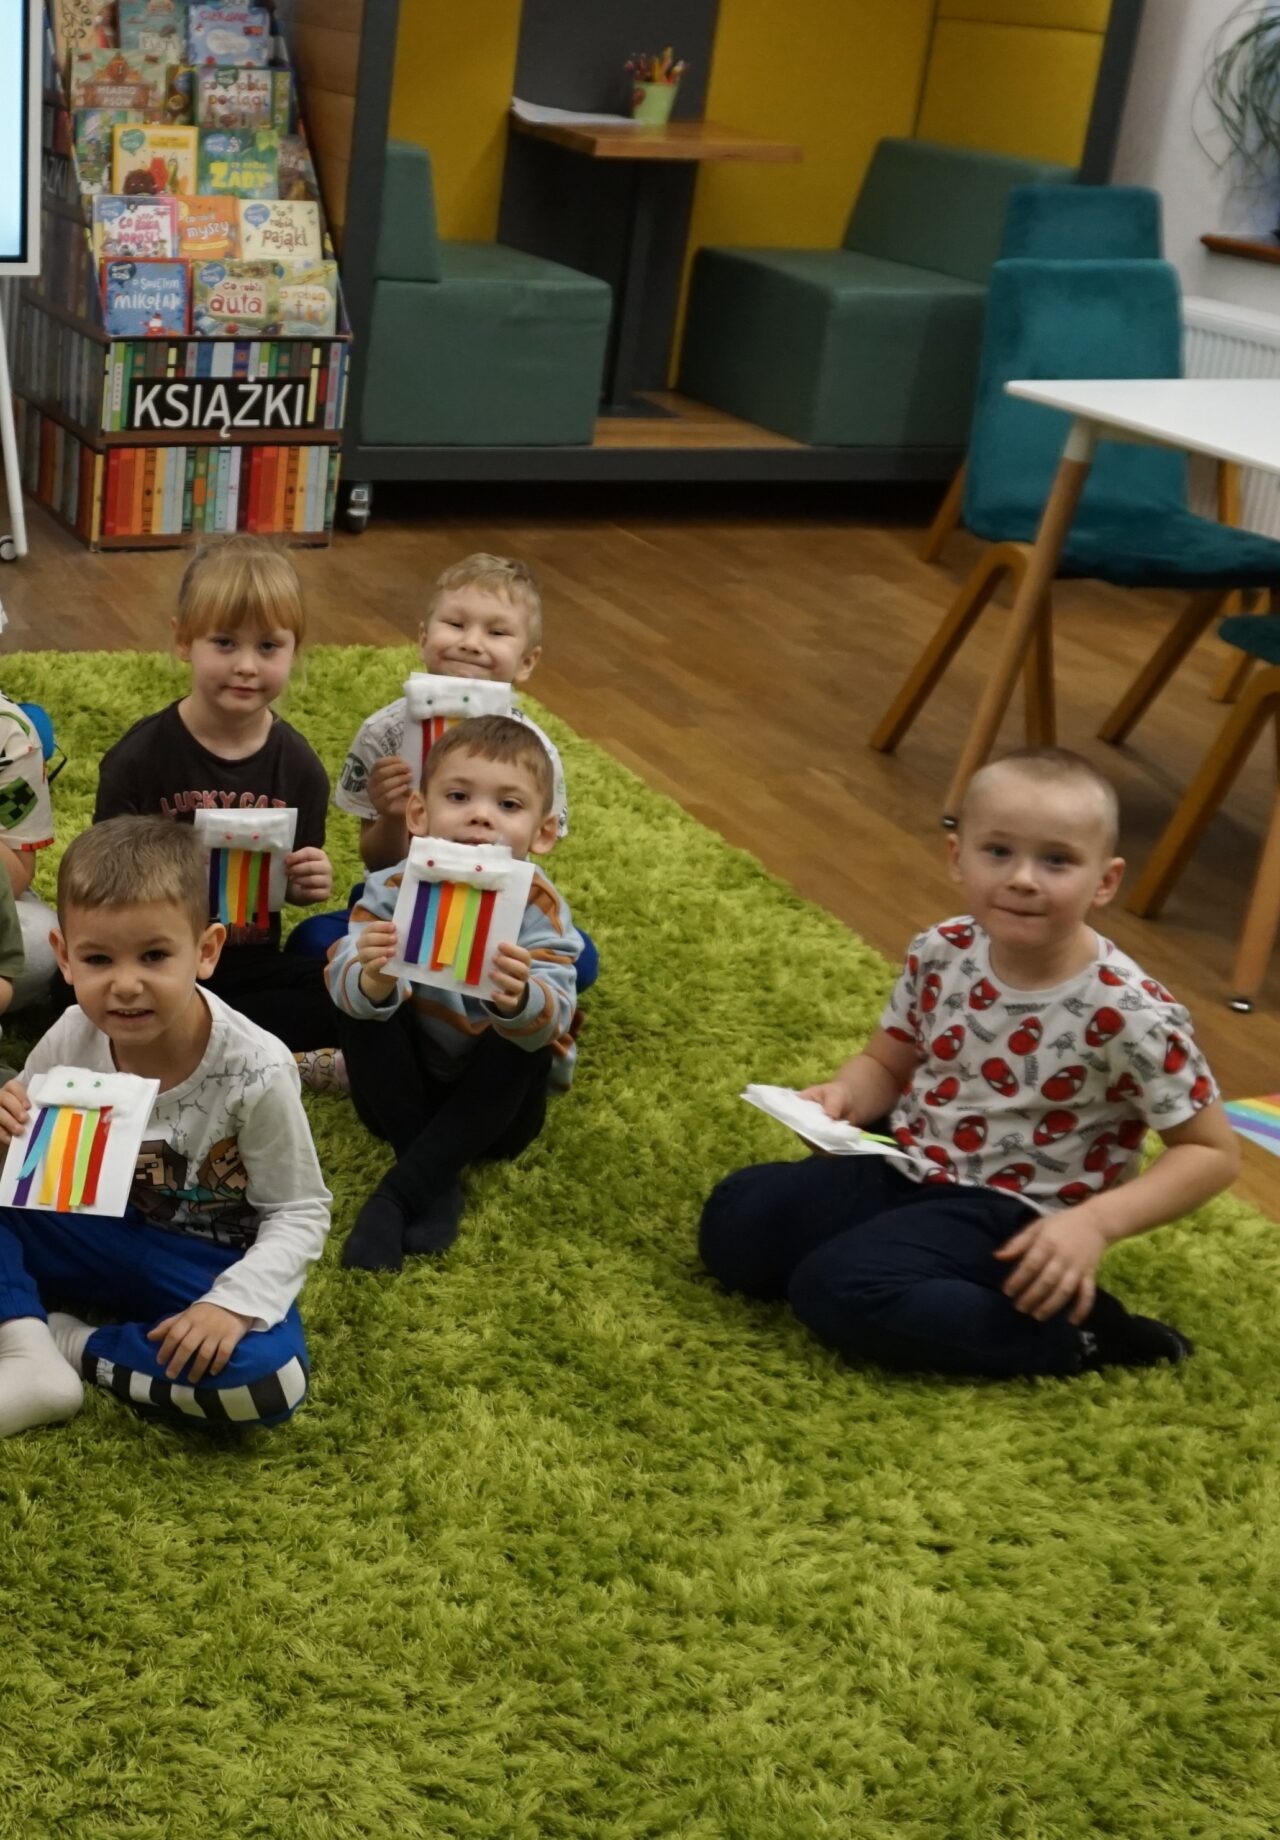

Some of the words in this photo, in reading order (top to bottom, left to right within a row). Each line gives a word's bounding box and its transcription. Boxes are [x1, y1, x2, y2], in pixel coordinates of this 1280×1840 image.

[209, 293, 262, 314] auta
[133, 375, 305, 438] KSIĄŻKI
[161, 789, 237, 816] LUCKY
